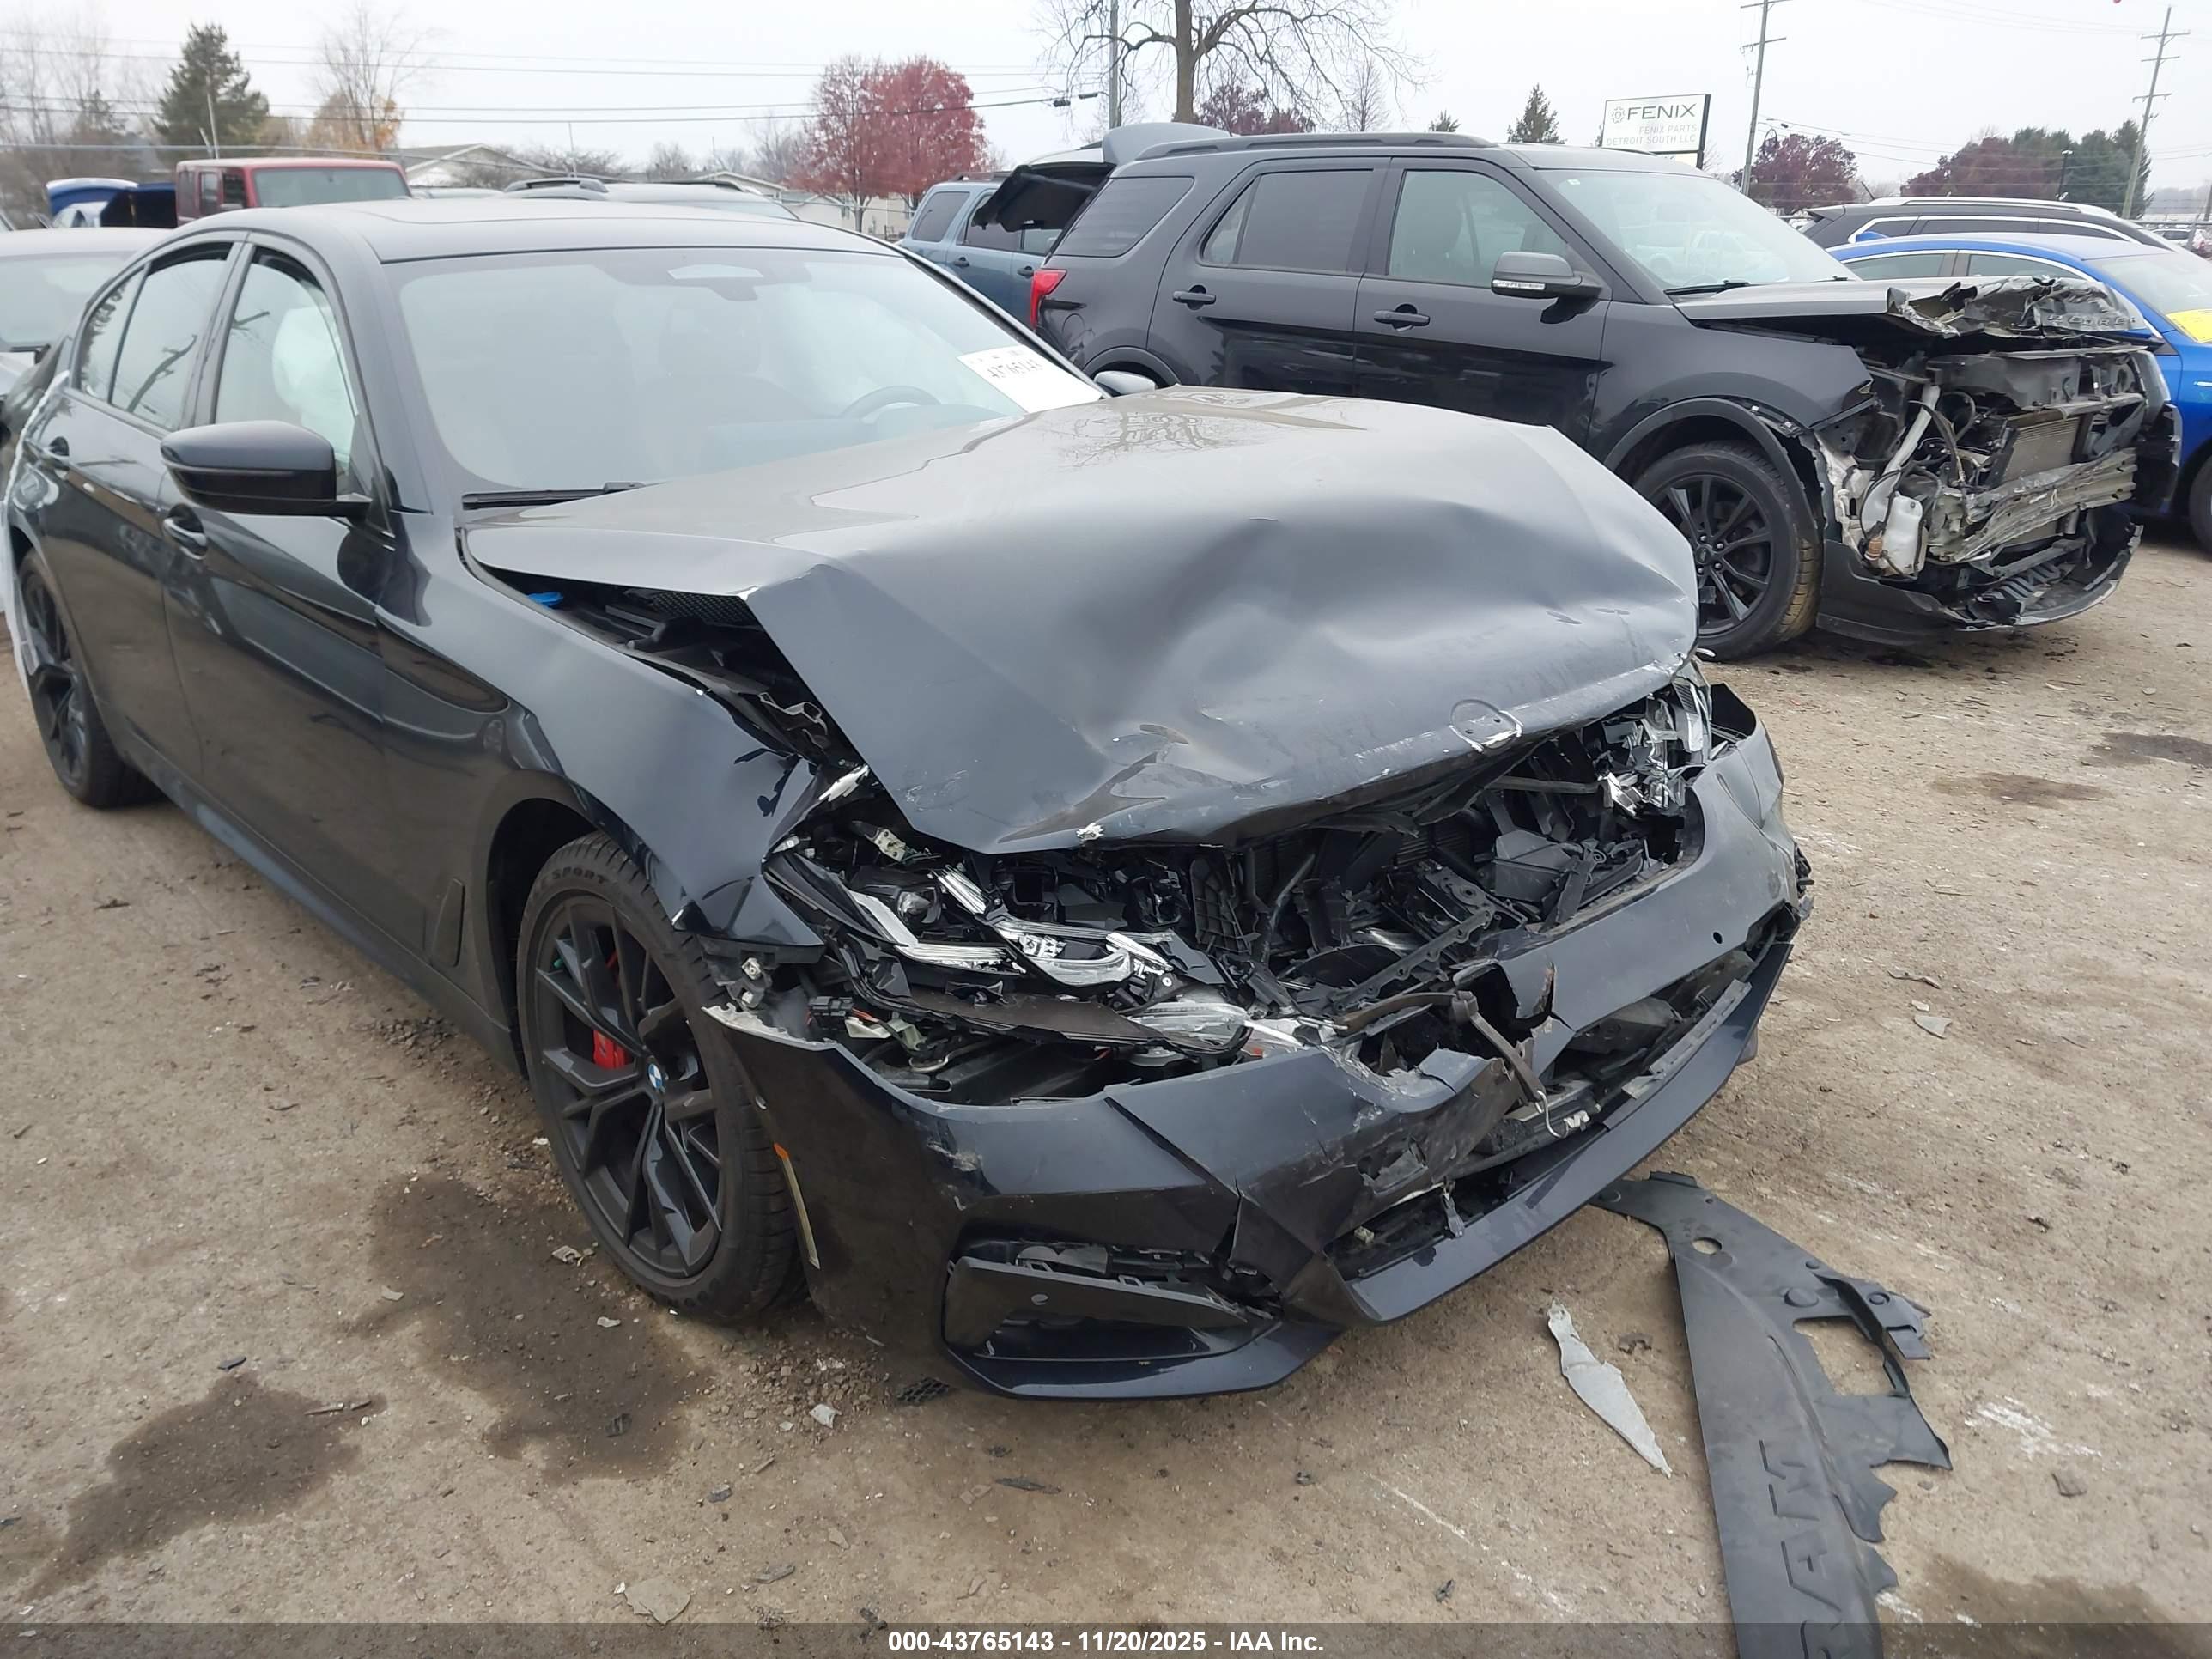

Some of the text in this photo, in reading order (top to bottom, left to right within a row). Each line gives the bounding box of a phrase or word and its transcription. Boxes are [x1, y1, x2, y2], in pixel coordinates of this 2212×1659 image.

[1627, 103, 1697, 120] FENIX
[1639, 124, 1697, 135] FENIX PARTS
[1607, 134, 1696, 146] DETROIT SOUTH LLC
[551, 866, 608, 884] SPORT
